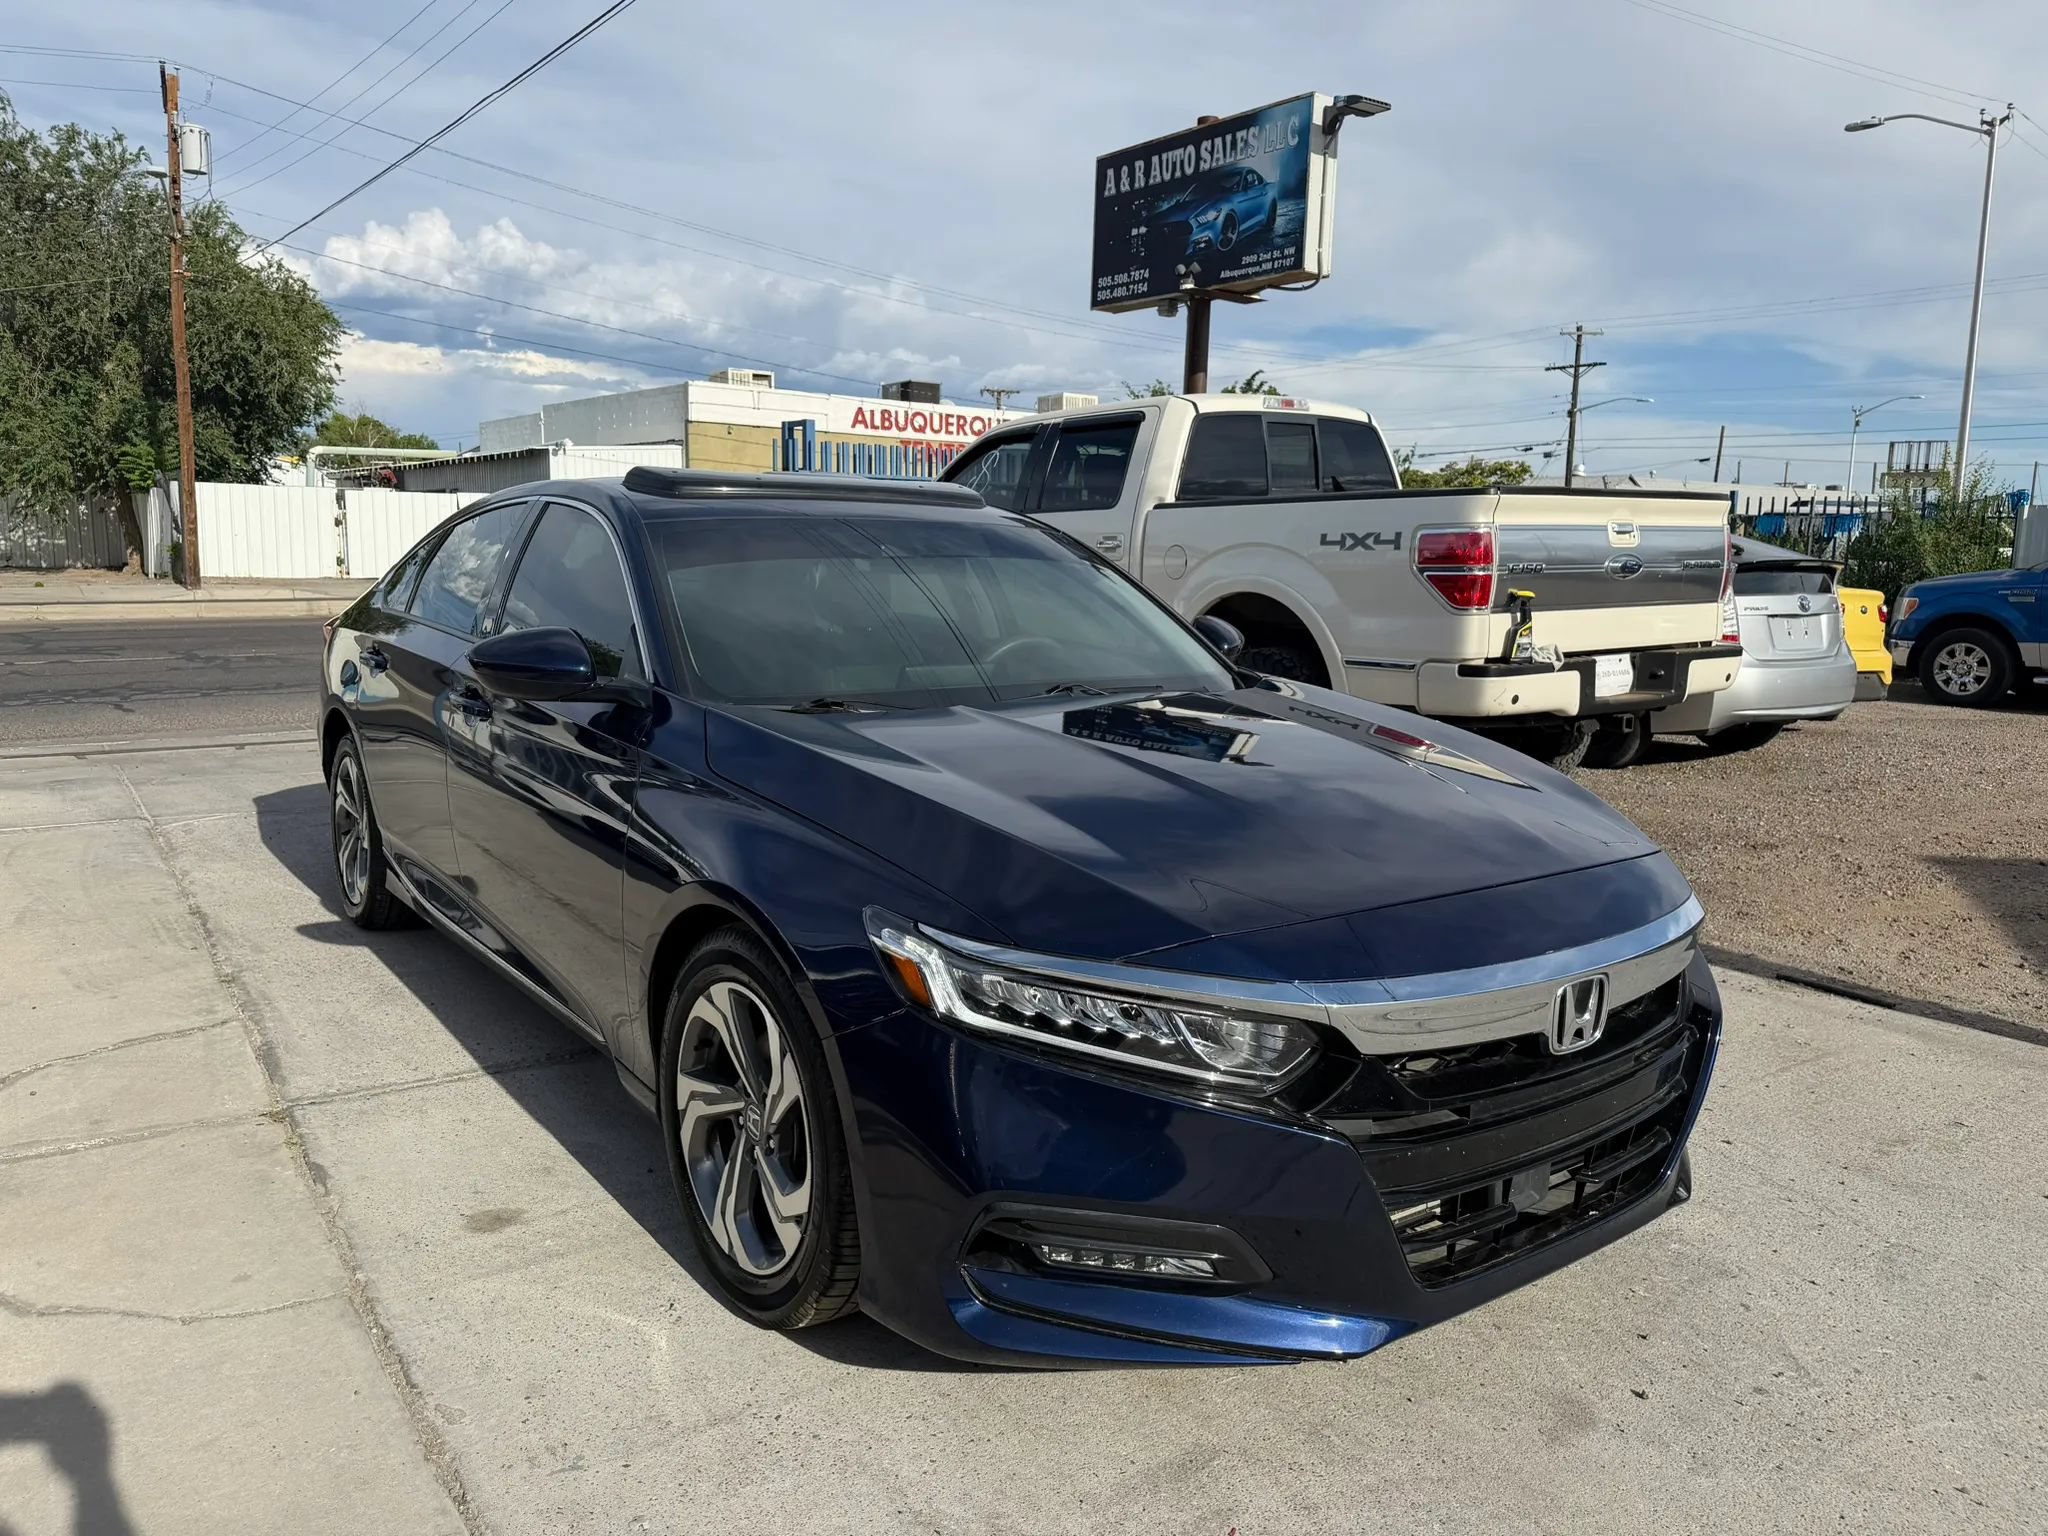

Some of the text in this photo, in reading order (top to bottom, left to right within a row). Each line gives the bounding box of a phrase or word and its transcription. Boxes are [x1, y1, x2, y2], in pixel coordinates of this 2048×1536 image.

[1104, 113, 1300, 198] A & R AUTO SALES LLC
[1259, 251, 1272, 261] 2nd
[1283, 246, 1297, 256] NW
[1274, 257, 1295, 269] 87107
[1097, 267, 1150, 288] 505.508.7874
[1096, 281, 1148, 301] 505.480.7154
[851, 407, 1011, 438] ALBUQUERQ
[1319, 531, 1402, 552] 4X4
